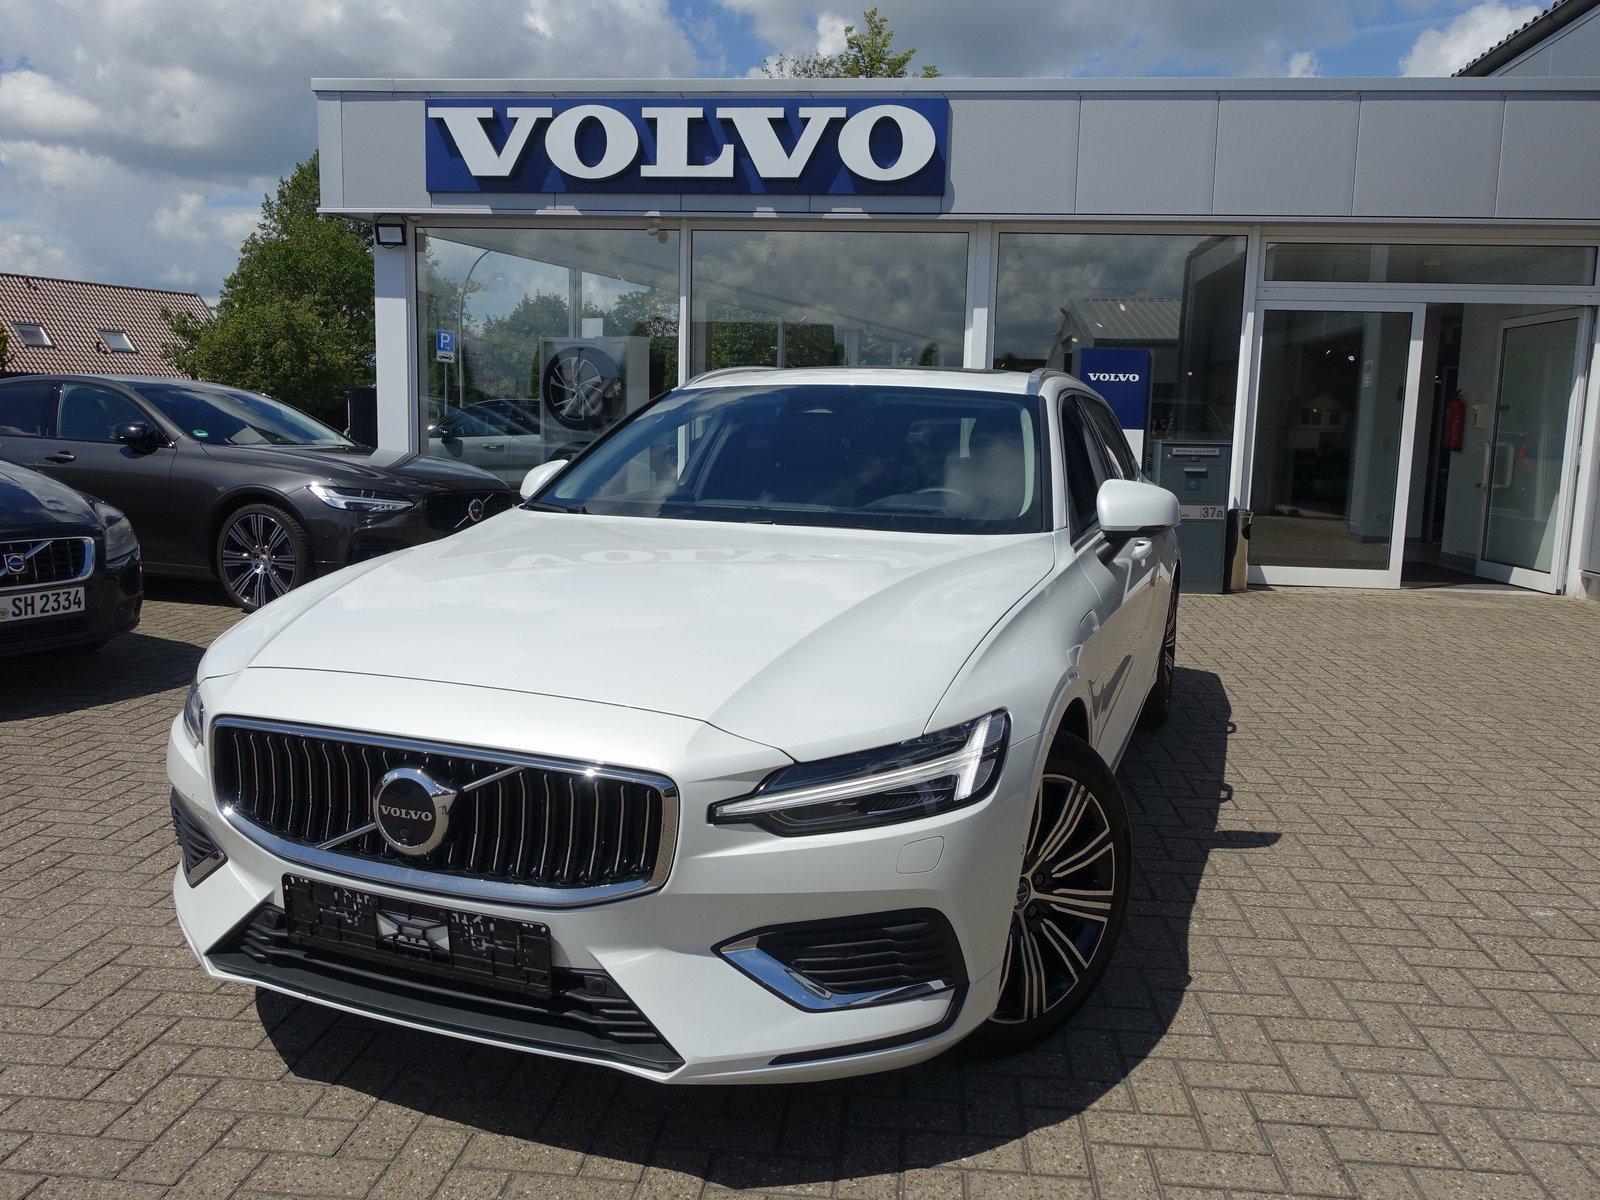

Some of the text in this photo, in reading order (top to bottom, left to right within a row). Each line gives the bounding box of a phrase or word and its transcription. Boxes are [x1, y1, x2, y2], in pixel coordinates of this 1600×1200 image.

[427, 104, 936, 181] VOLVO
[440, 332, 451, 349] P
[1087, 372, 1140, 382] VOLVO
[1201, 506, 1224, 519] 37a
[11, 590, 83, 618] SH 2334
[380, 804, 433, 822] VOLVO
